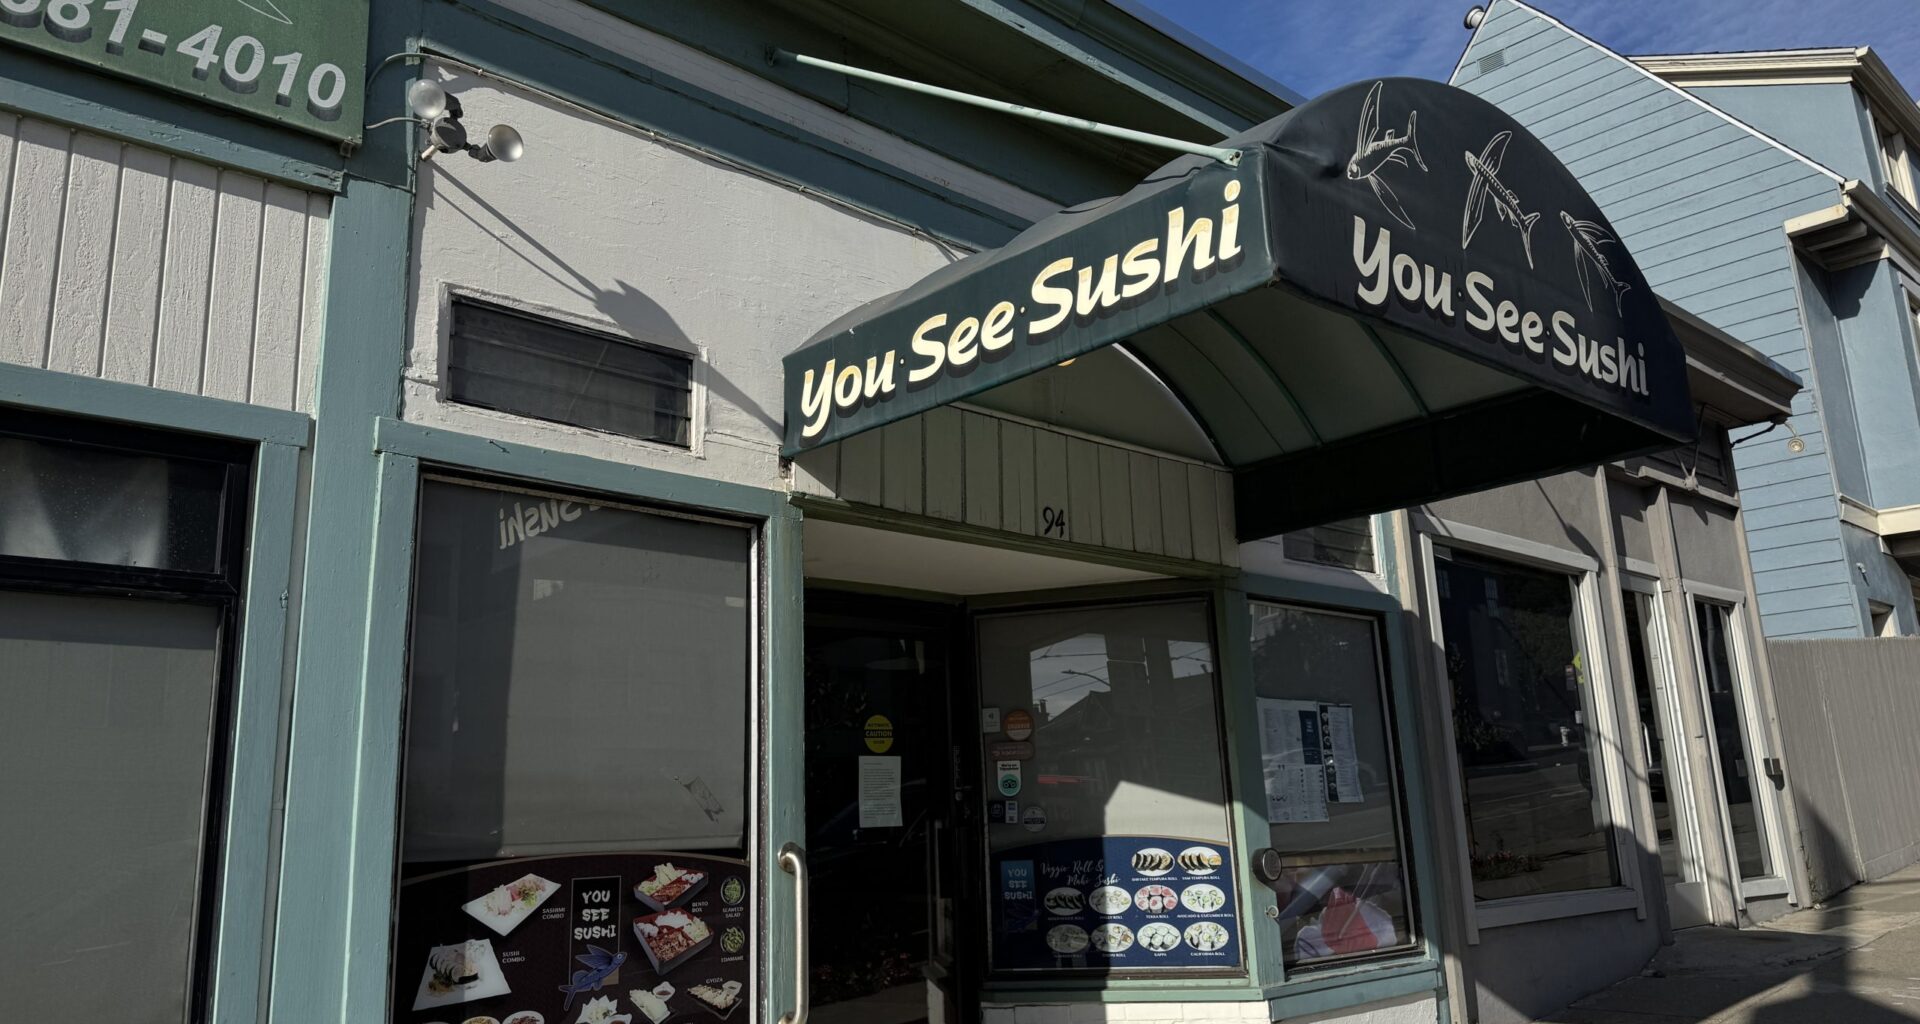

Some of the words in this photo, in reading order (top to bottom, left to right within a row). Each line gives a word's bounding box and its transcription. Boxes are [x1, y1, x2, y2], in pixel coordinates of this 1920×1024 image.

[0, 0, 347, 112] 81-4010
[908, 301, 1015, 383] See
[1028, 179, 1242, 335] Sushi
[1465, 271, 1544, 354] See
[1551, 310, 1649, 397] Sushi
[1042, 506, 1066, 538] 94
[1008, 868, 1028, 877] YOU
[1008, 879, 1028, 889] SEE
[581, 889, 611, 905] YOU
[1004, 890, 1033, 900] SUSHI
[581, 907, 610, 922] SEE
[573, 924, 616, 941] SUSHI
[502, 956, 525, 964] COMBO
[720, 955, 744, 963] EDAMAME
